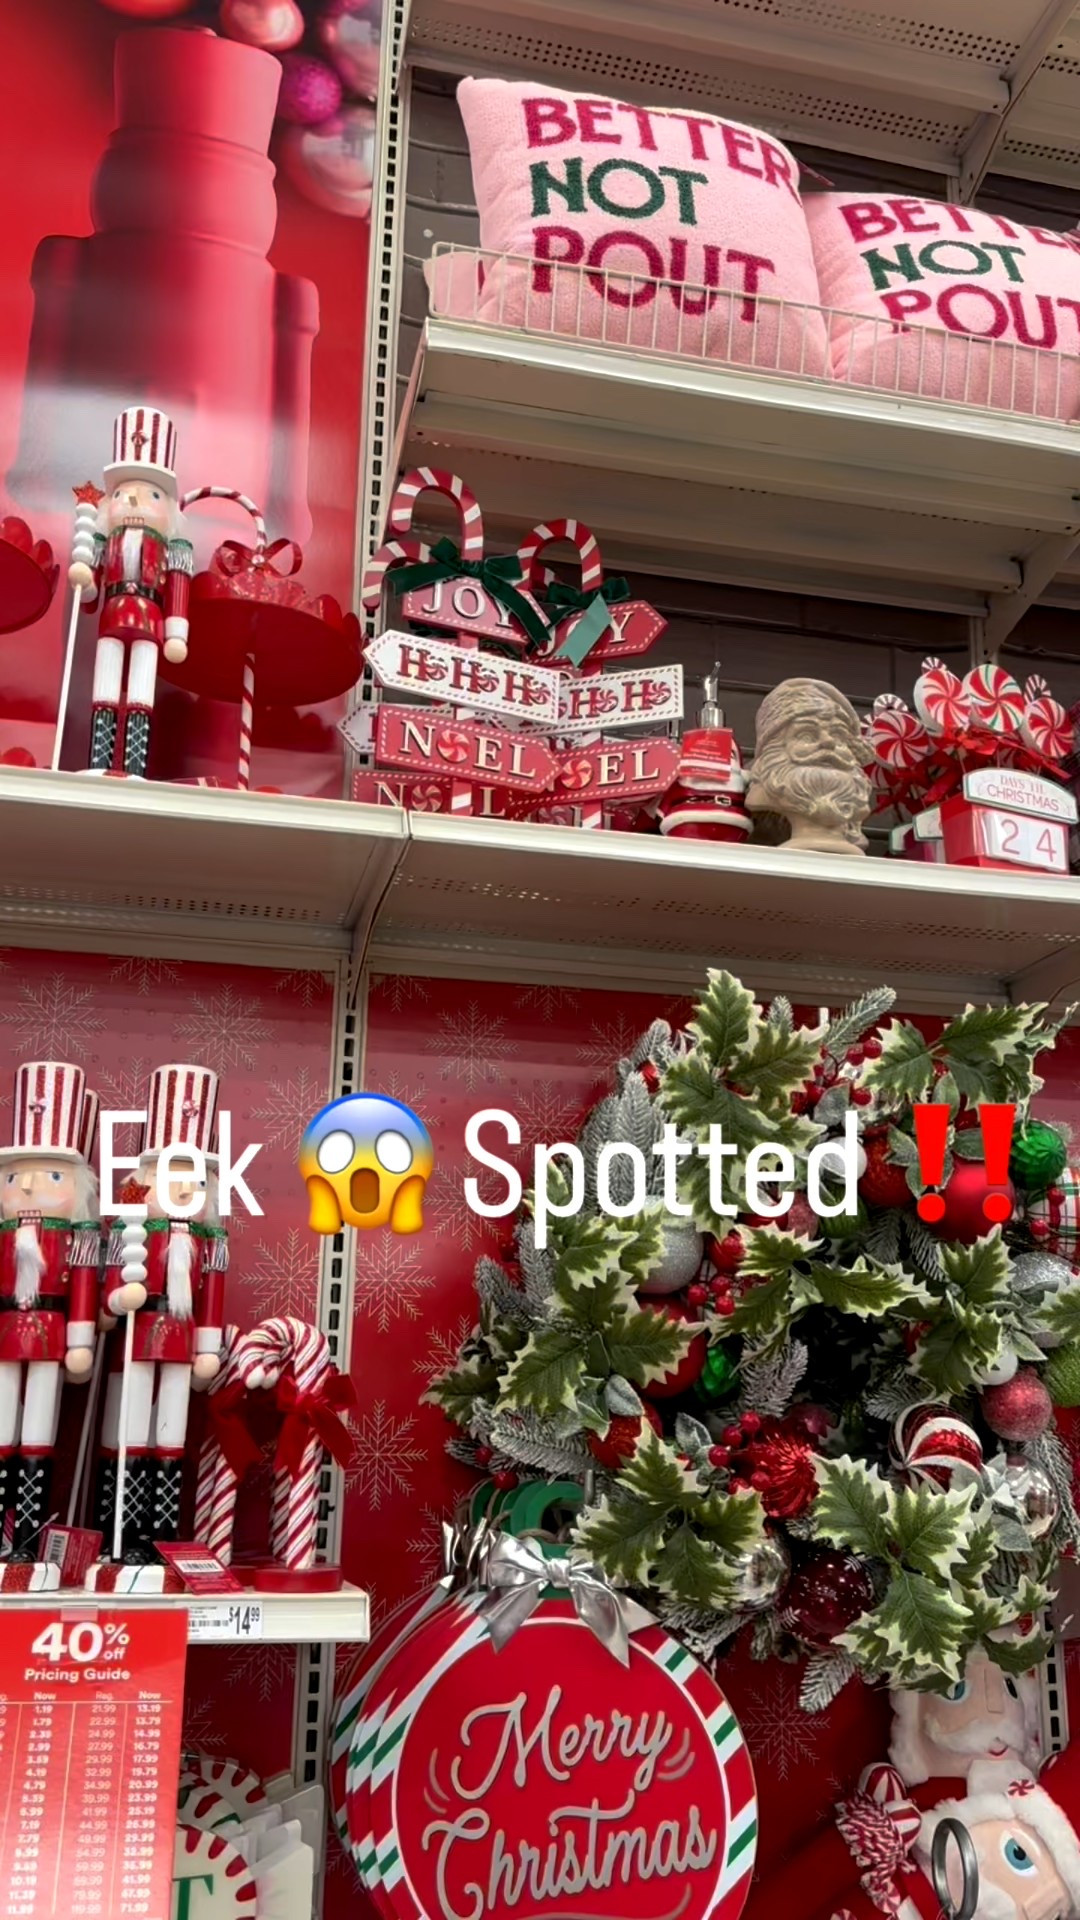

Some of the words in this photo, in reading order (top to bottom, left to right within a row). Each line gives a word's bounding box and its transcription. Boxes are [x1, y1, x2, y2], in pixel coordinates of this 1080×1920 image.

[522, 97, 802, 208] BETTER
[529, 157, 708, 225] NOT
[838, 199, 1080, 256] BETTE
[532, 226, 775, 322] POUT
[860, 240, 1026, 291] NOT
[987, 784, 1060, 812] CHRISTMAS
[24, 1668, 79, 1683] Pricing
[83, 1667, 131, 1681] Guide
[103, 1647, 126, 1661] off
[451, 1684, 673, 1800] Merry
[422, 1789, 717, 1920] Christmas
